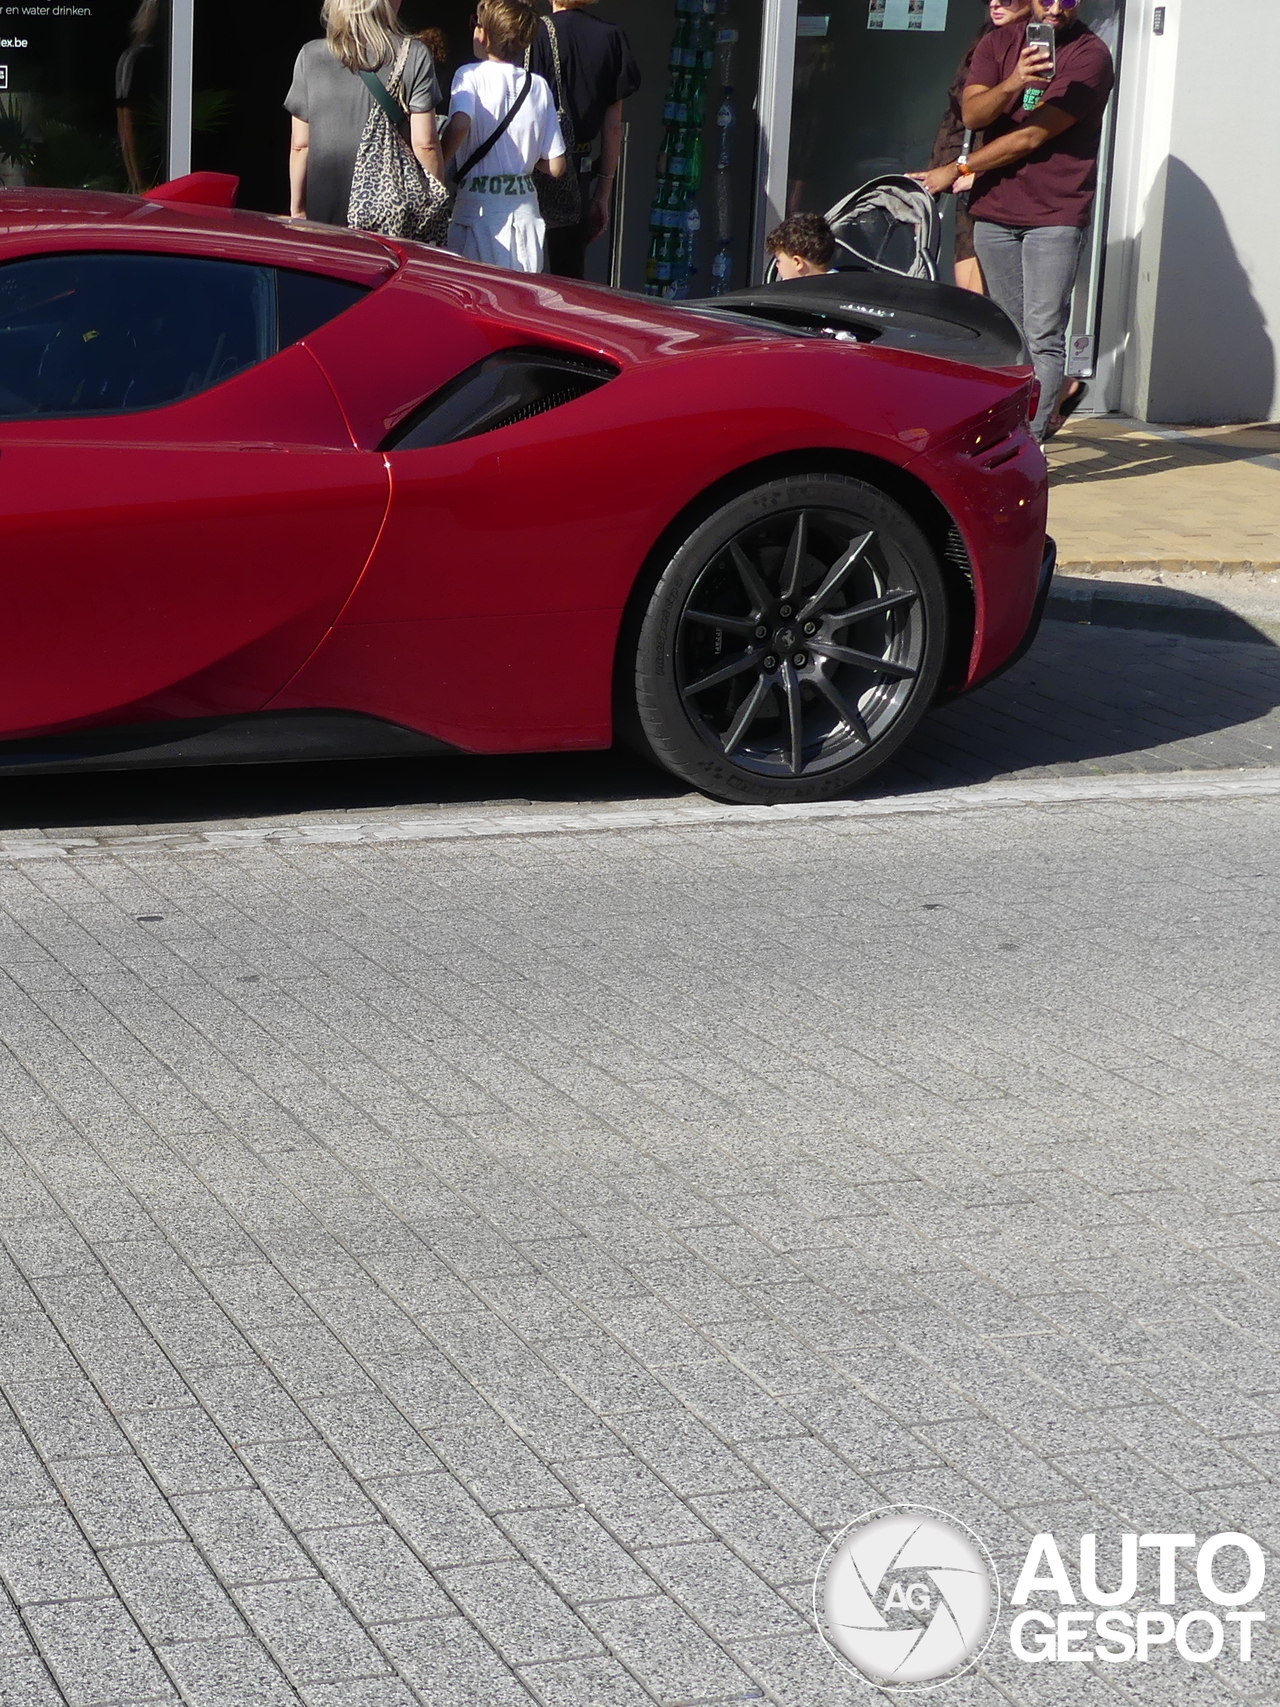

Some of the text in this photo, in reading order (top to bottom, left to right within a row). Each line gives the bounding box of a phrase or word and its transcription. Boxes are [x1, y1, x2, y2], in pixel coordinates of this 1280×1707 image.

[5, 7, 19, 15] en
[21, 6, 50, 15] water
[52, 5, 93, 16] drinken.
